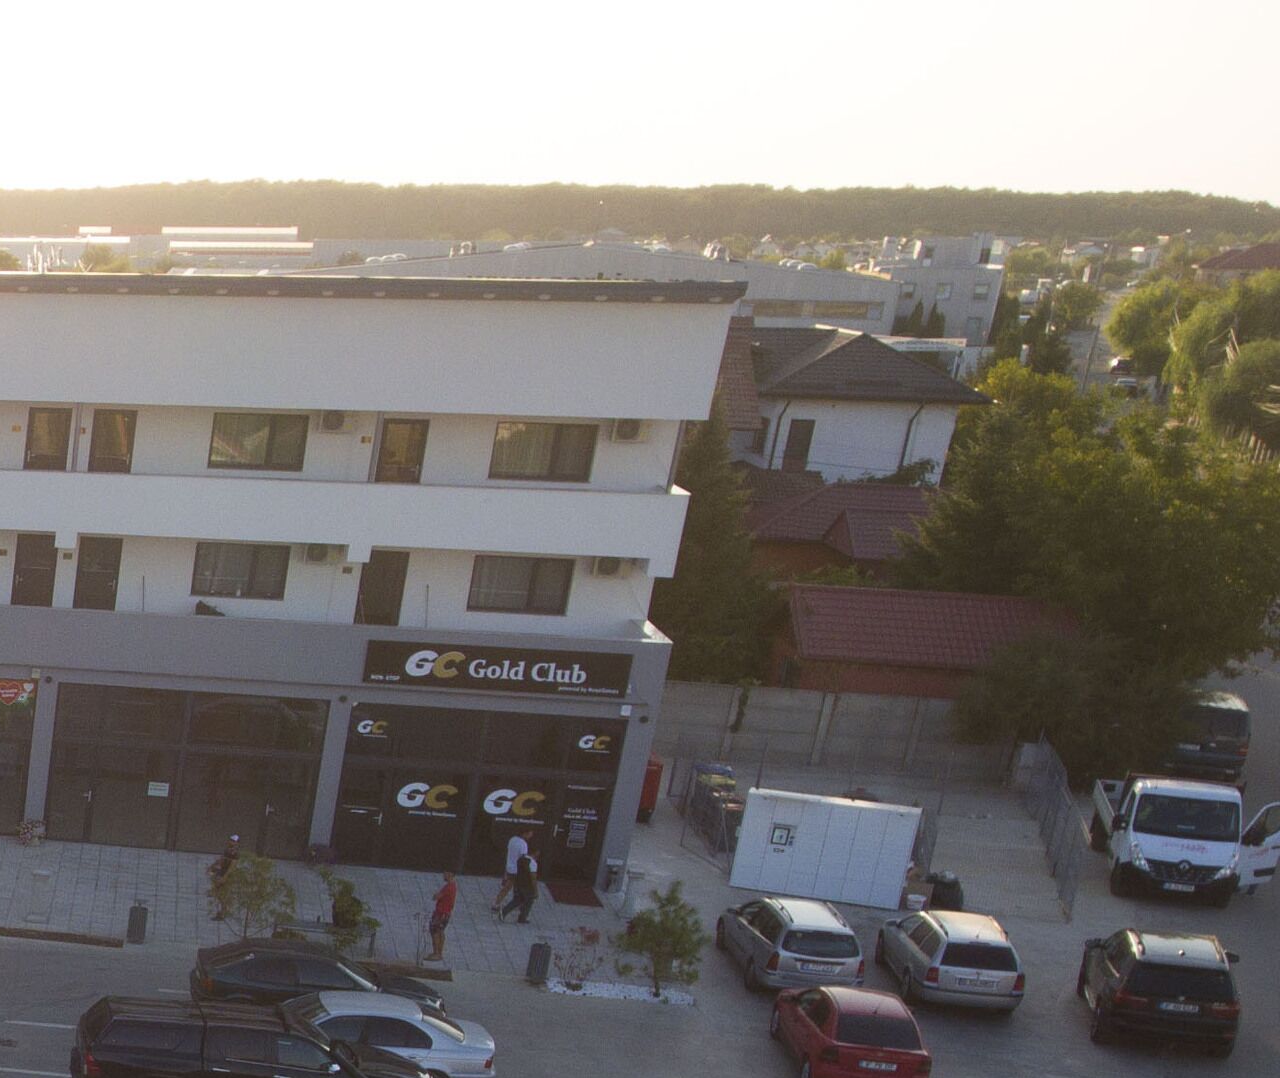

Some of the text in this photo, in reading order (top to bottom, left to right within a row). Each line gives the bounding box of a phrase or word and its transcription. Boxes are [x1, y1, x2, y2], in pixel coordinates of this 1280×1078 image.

[405, 650, 466, 678] GC
[468, 659, 587, 684] Gold Club
[397, 782, 458, 809] GC
[483, 789, 545, 816] GC
